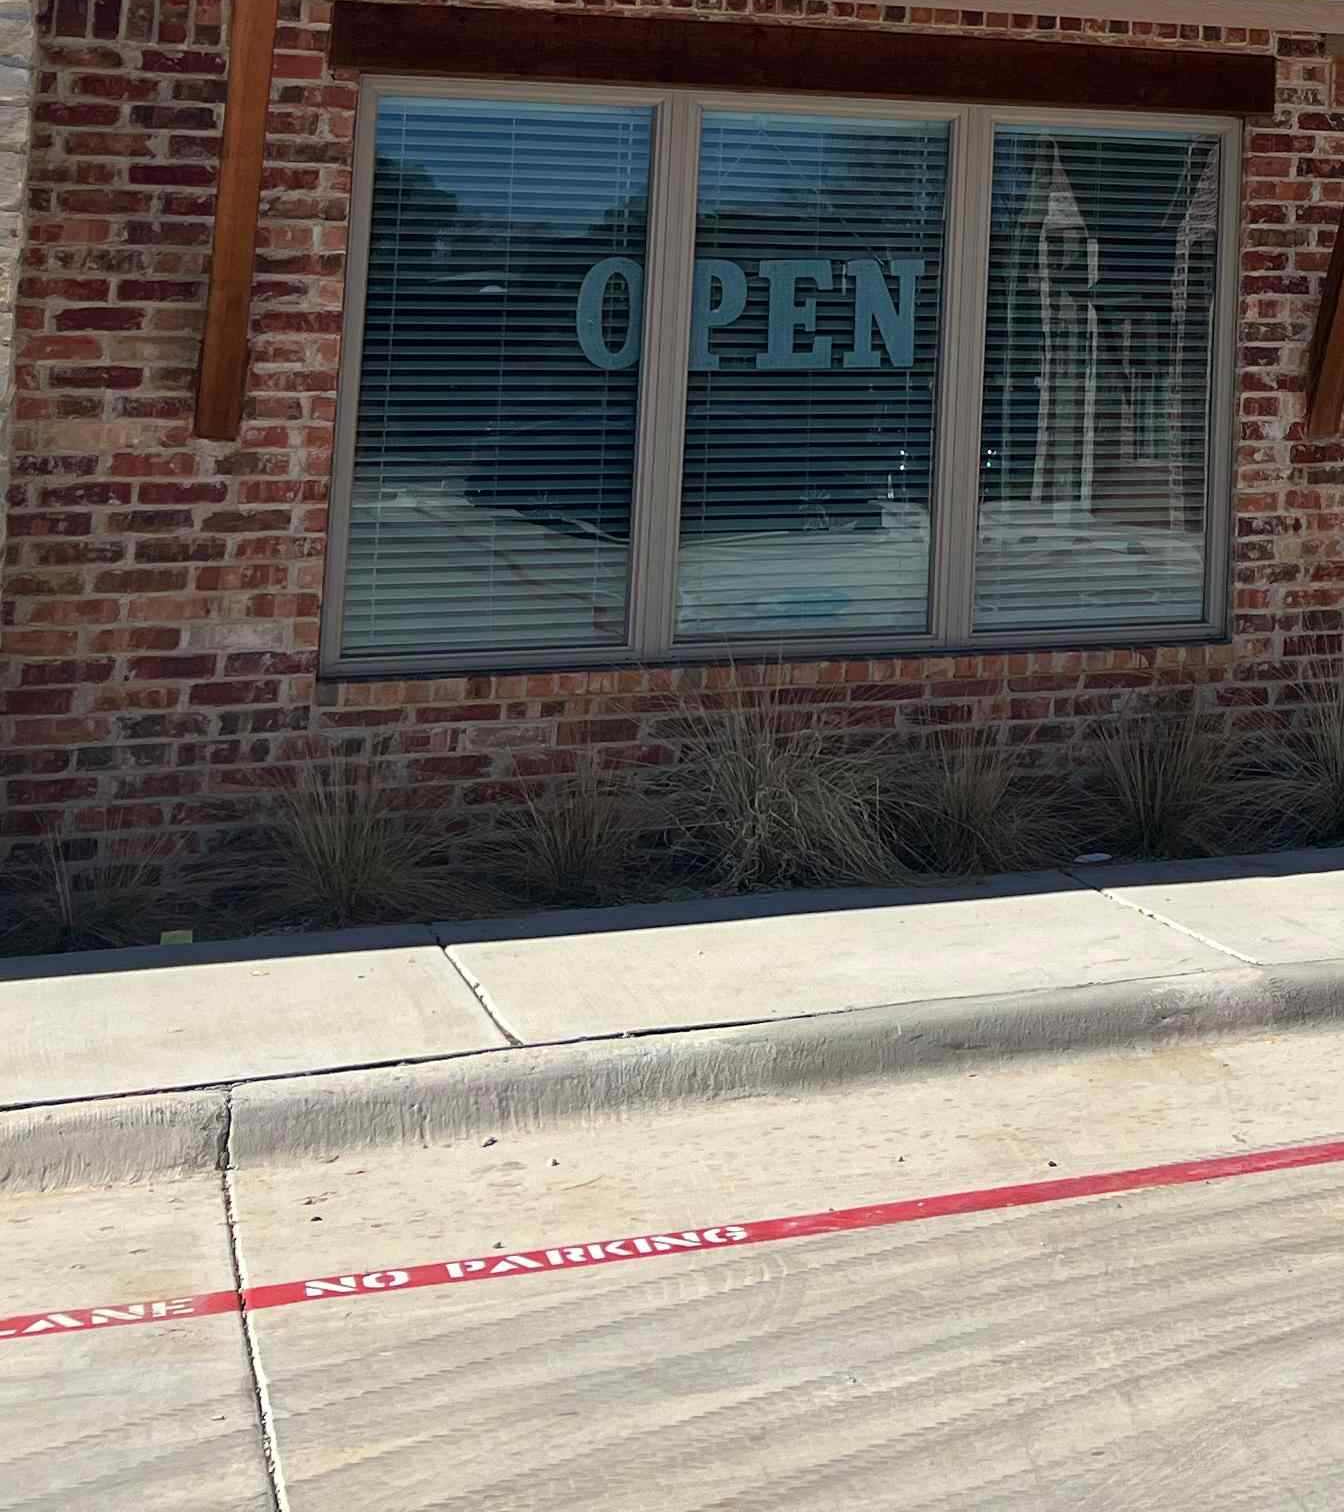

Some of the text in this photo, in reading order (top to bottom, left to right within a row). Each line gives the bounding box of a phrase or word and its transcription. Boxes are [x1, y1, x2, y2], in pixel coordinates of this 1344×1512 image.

[576, 256, 925, 371] OPEN
[304, 1269, 409, 1297] NO
[445, 1225, 749, 1280] PARKING
